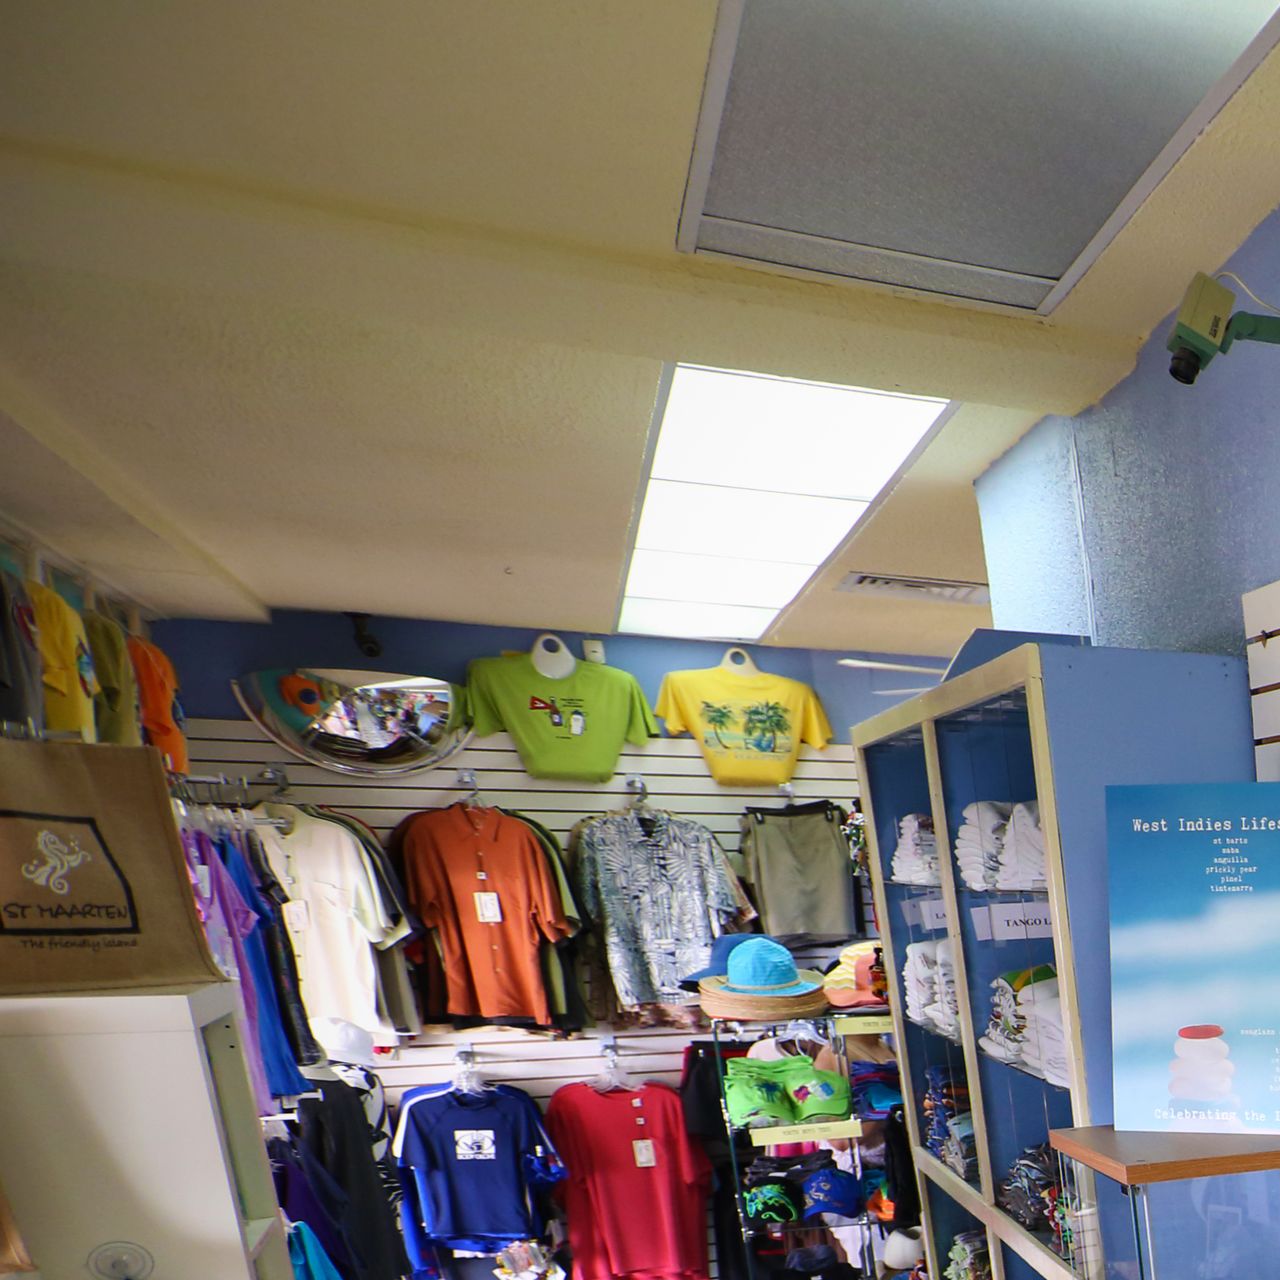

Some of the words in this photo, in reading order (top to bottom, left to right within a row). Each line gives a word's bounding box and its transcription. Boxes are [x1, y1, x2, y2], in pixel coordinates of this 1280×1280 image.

[1132, 818, 1168, 833] West
[1178, 817, 1232, 832] Indies
[1213, 856, 1248, 865] anguilla
[1205, 866, 1236, 875] prickly
[2, 902, 31, 919] ST
[37, 903, 128, 919] MAARTEN
[1004, 918, 1042, 928] TANGO
[1153, 1108, 1236, 1121] Celebrating
[1244, 1110, 1266, 1121] the
